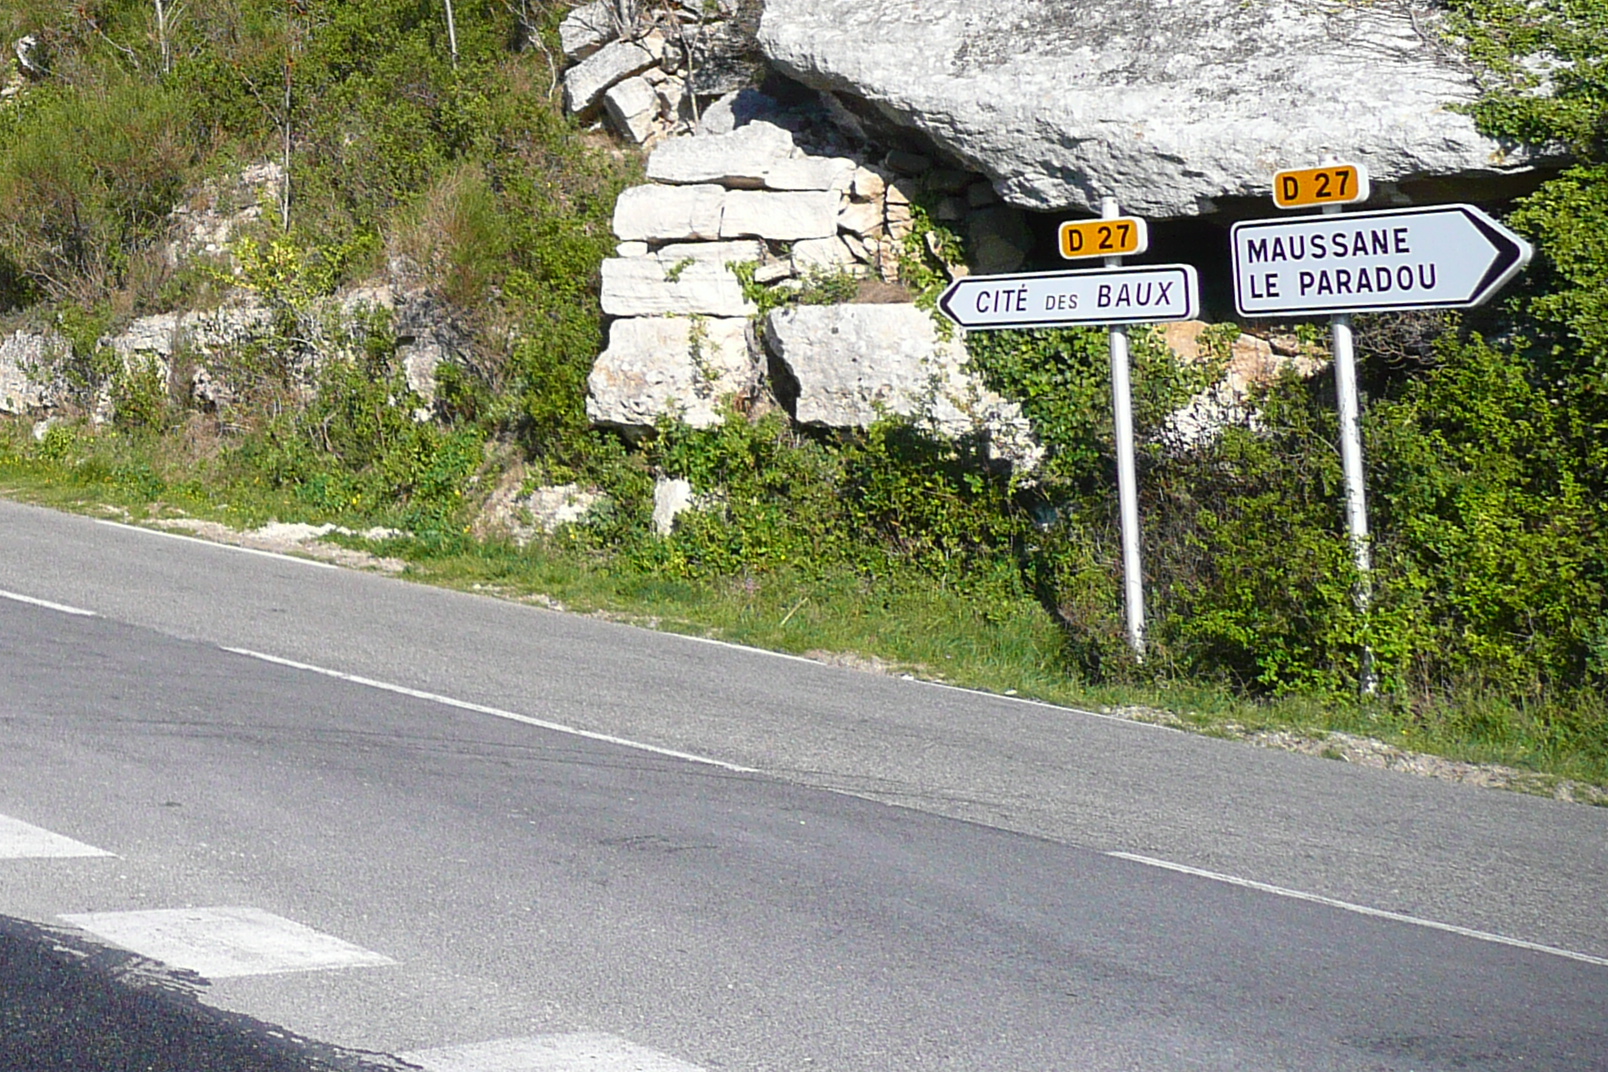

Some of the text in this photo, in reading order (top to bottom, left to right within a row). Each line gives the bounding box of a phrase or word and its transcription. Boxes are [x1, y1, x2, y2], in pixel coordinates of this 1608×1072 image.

[1283, 170, 1350, 201] D 27
[1068, 224, 1130, 252] D 27
[1247, 227, 1410, 263] MAUSSANE
[976, 281, 1173, 313] CITÉ DES BAUX
[1250, 263, 1436, 299] LE PARADOU
